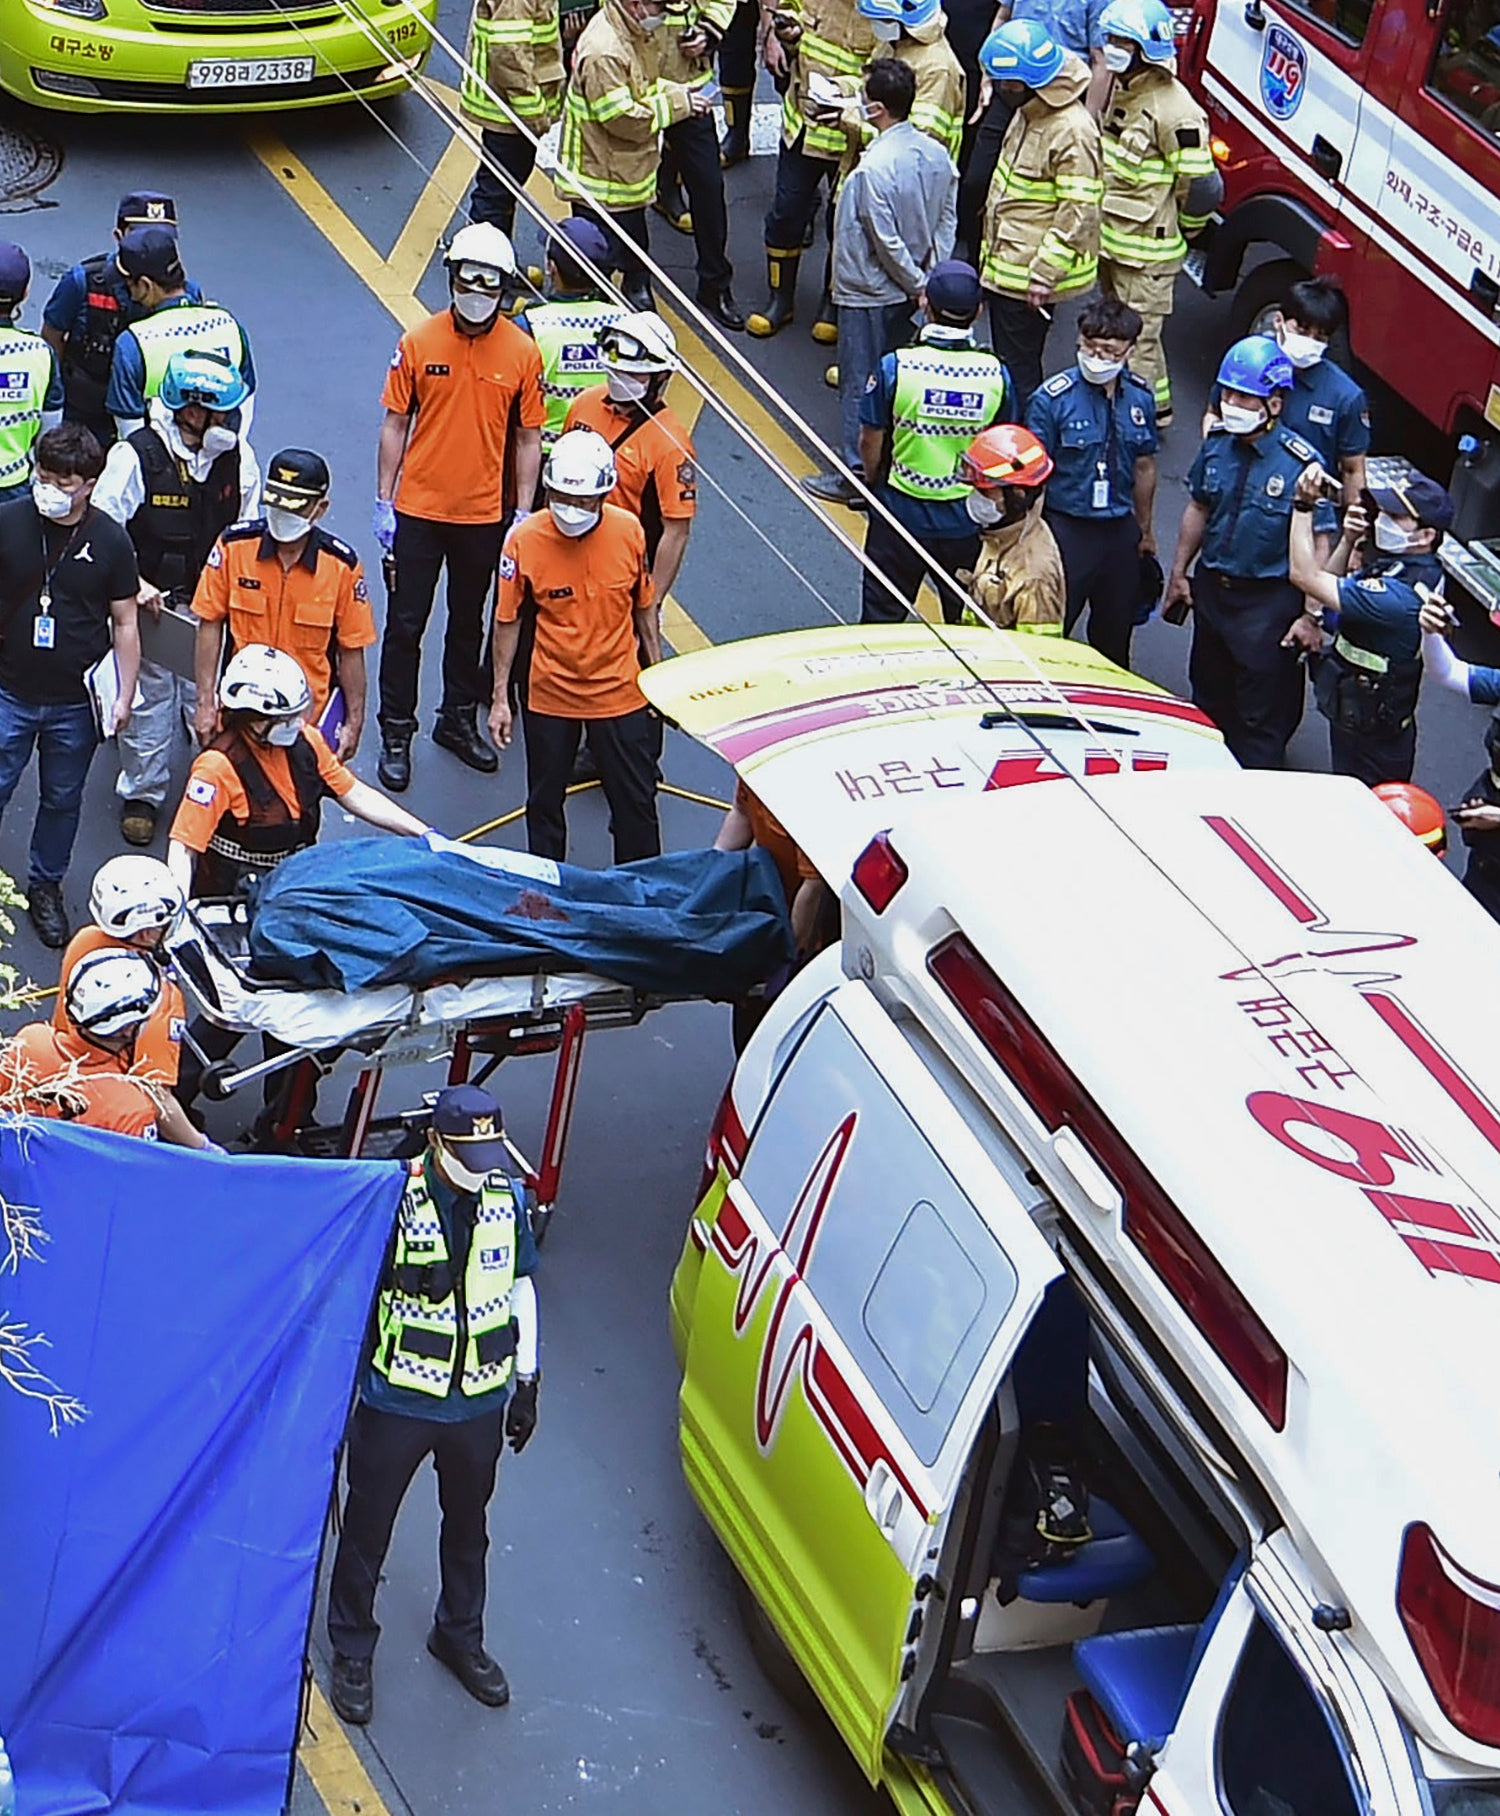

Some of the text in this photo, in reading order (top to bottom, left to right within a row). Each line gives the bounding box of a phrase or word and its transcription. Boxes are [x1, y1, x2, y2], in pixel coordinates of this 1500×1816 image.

[50, 35, 115, 62] 대구소방
[198, 61, 306, 85] 998라 2338
[1265, 49, 1302, 100] 119
[926, 406, 977, 418] POLICE
[834, 756, 965, 802] 구급대
[1236, 996, 1356, 1090] 구급대
